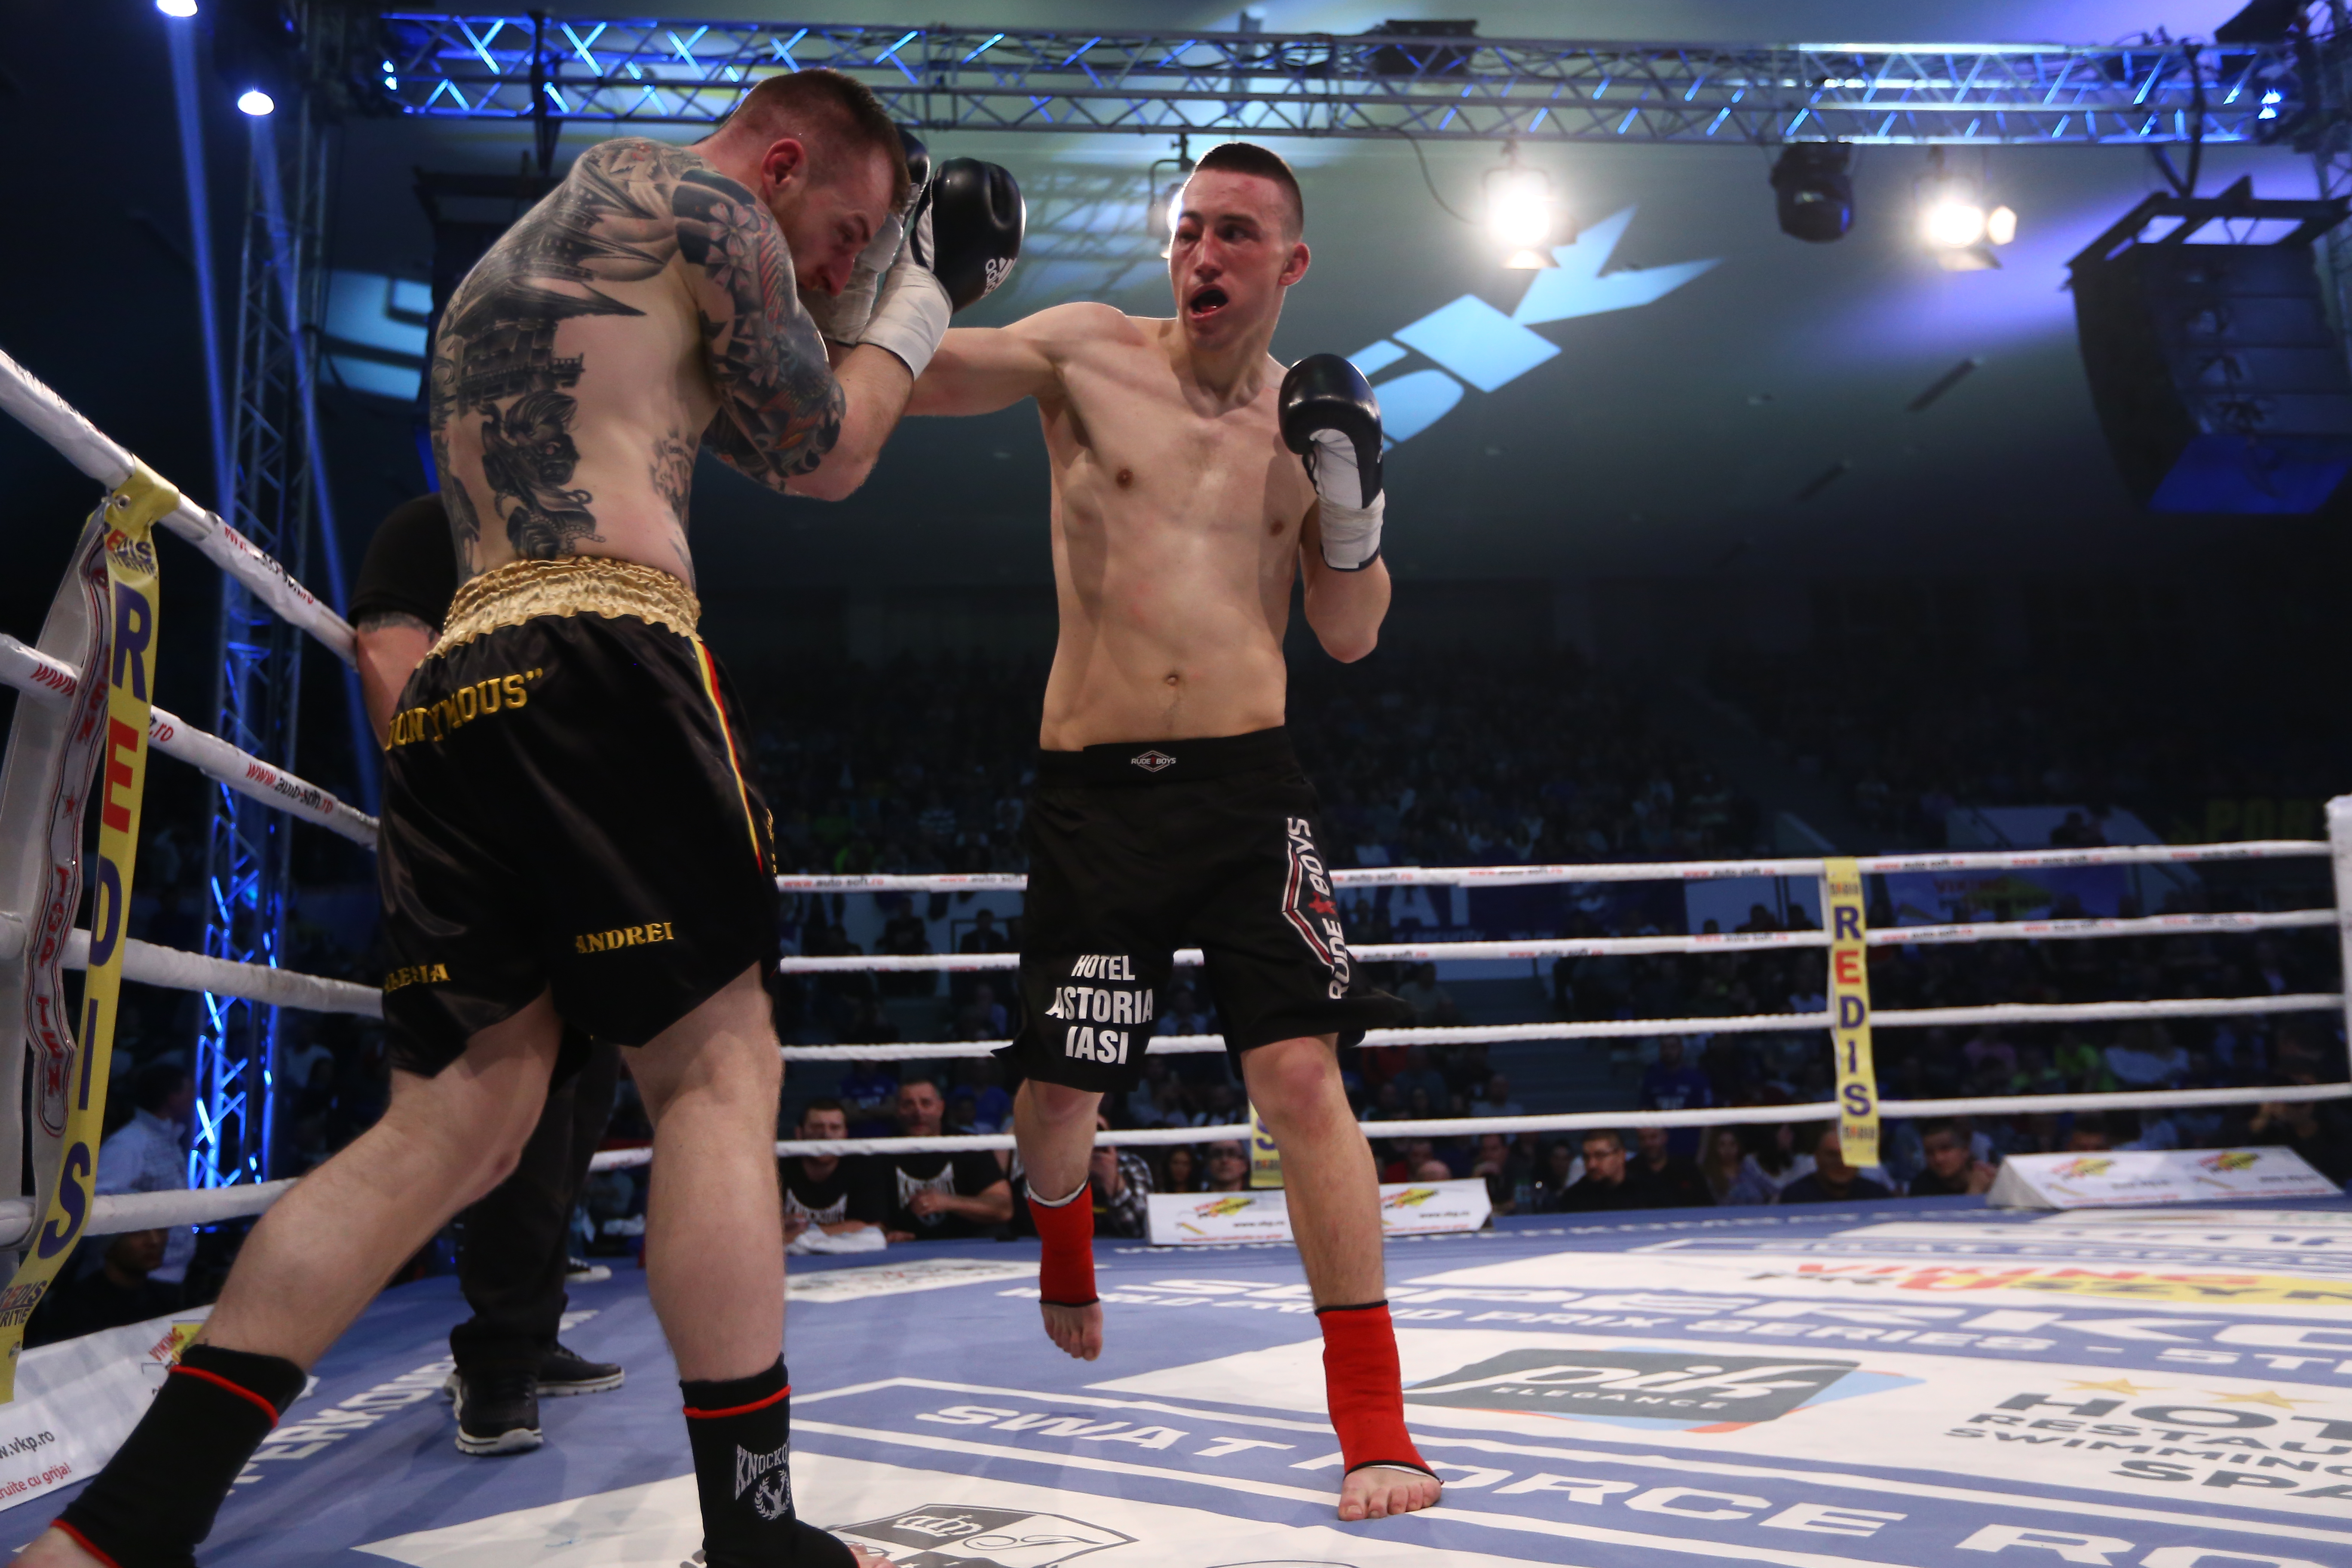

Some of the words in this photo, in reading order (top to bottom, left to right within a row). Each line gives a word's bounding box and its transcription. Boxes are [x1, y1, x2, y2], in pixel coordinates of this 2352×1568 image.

[1287, 817, 1331, 897] BOYS
[39, 866, 70, 968] TOP
[576, 922, 674, 954] ANDREI
[1071, 954, 1136, 982] HOTEL
[1328, 918, 1350, 999] RUDE
[1044, 986, 1153, 1025] ASTORIA
[1834, 906, 1871, 1116] REDIS
[36, 994, 64, 1099] TEN
[1065, 1026, 1130, 1065] IASI
[1466, 1310, 1676, 1329] PRIX
[1685, 1319, 2058, 1351] SERIES
[1493, 1387, 1728, 1410] ELEGANCE
[915, 1405, 1296, 1457] SWAT
[0, 1481, 27, 1499] ruite
[28, 1476, 42, 1487] cu
[42, 1462, 72, 1484] grija!
[735, 1439, 790, 1501] KNOCKO
